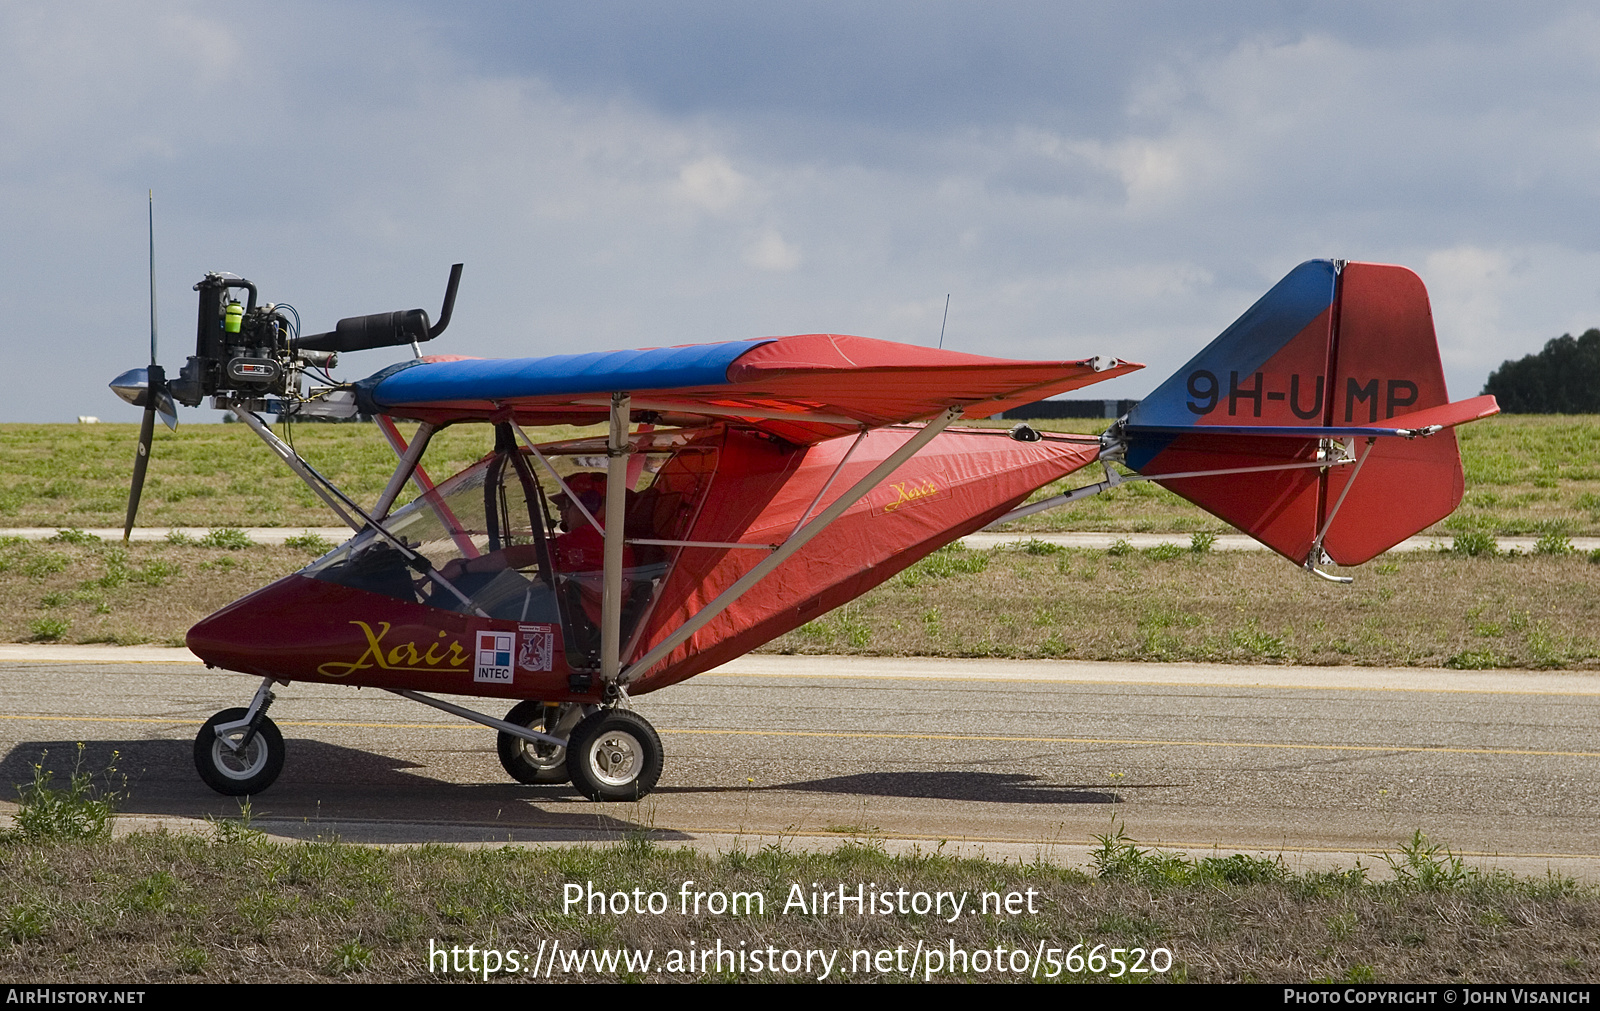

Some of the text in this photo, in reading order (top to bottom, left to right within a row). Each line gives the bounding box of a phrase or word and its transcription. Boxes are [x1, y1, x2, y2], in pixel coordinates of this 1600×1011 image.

[1186, 369, 1419, 423] 9H-UMP
[884, 480, 939, 512] Xair
[317, 620, 471, 677] Xair
[478, 667, 509, 680] INTEC
